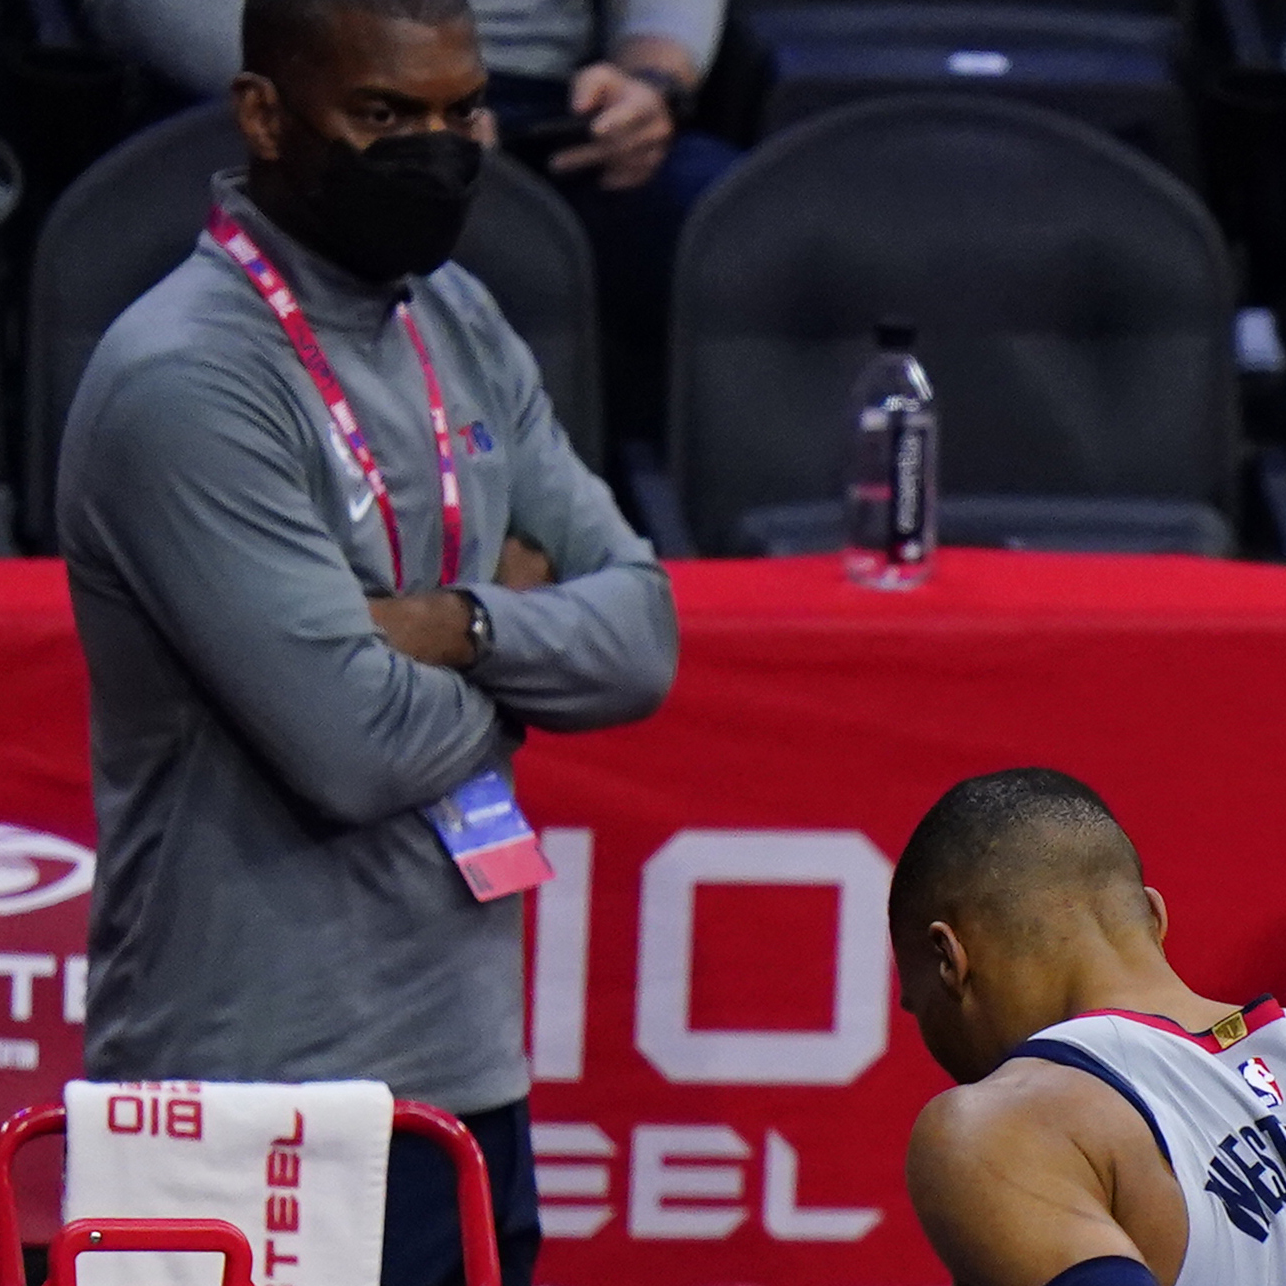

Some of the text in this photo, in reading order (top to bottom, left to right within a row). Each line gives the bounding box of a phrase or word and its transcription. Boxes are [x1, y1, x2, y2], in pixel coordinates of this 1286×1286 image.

[530, 827, 894, 1084] IO
[108, 1095, 202, 1140] BIO
[532, 1123, 883, 1241] EEL
